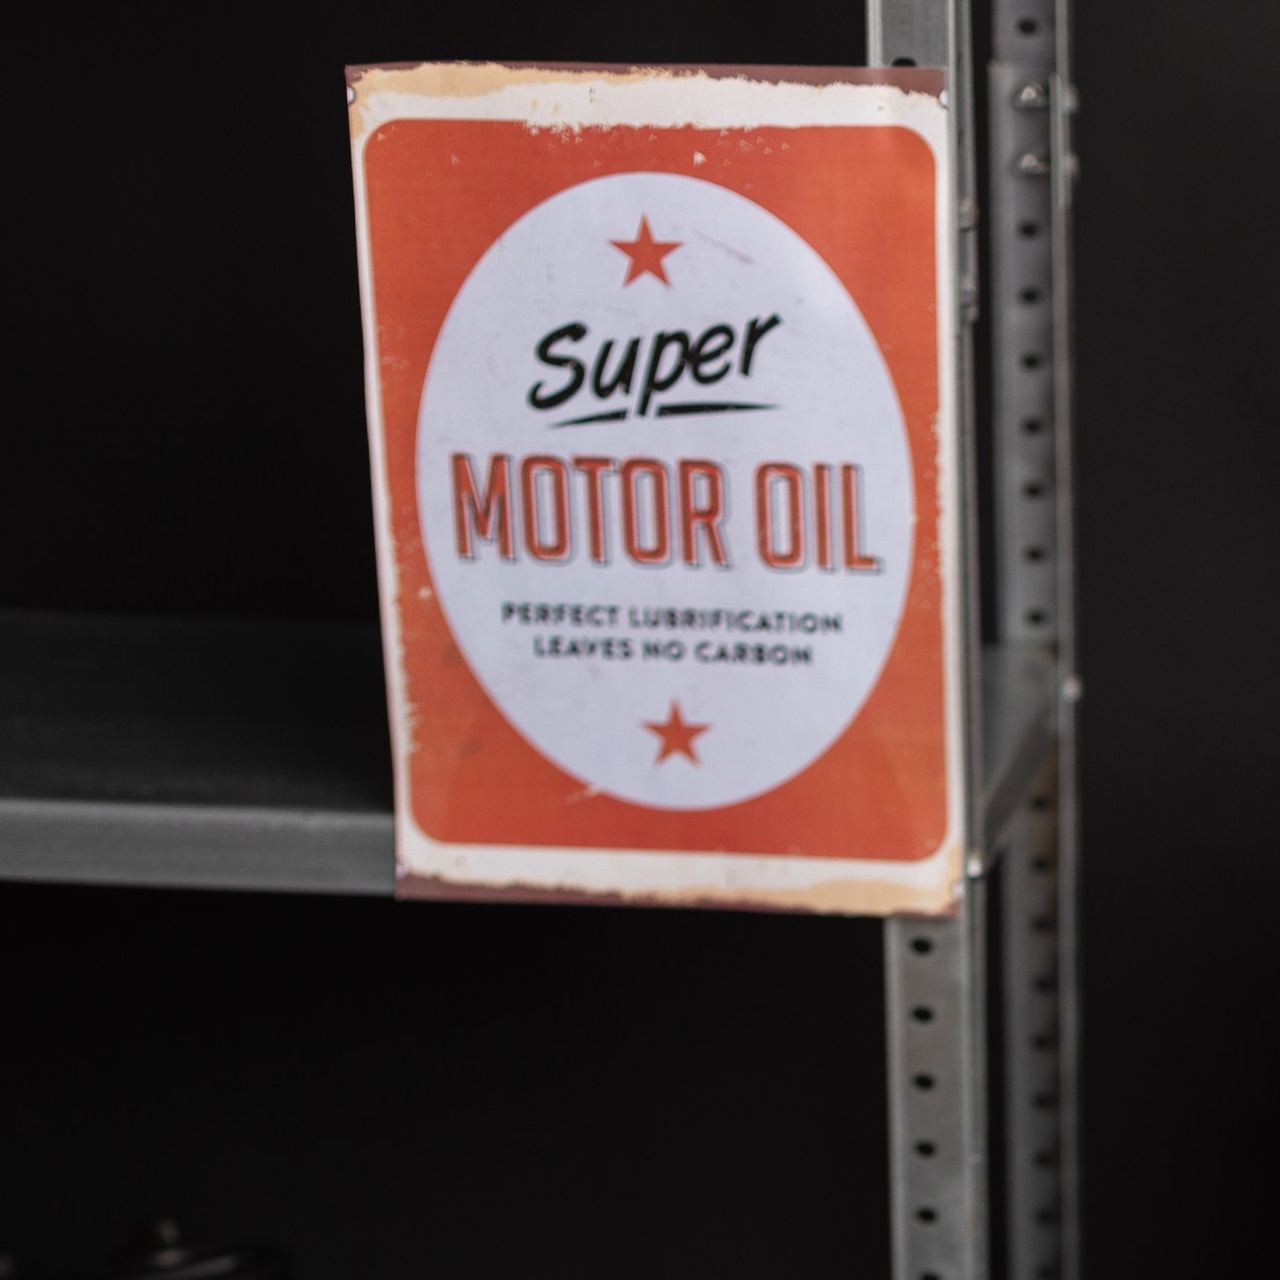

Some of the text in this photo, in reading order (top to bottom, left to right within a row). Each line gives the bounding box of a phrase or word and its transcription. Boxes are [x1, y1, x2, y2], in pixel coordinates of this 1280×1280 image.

[526, 312, 783, 418] Super
[450, 451, 886, 576] MOTOR OIL
[501, 602, 842, 635] PERFECT LUBRIFICATION
[533, 635, 814, 667] LEAVES NO CARBON
